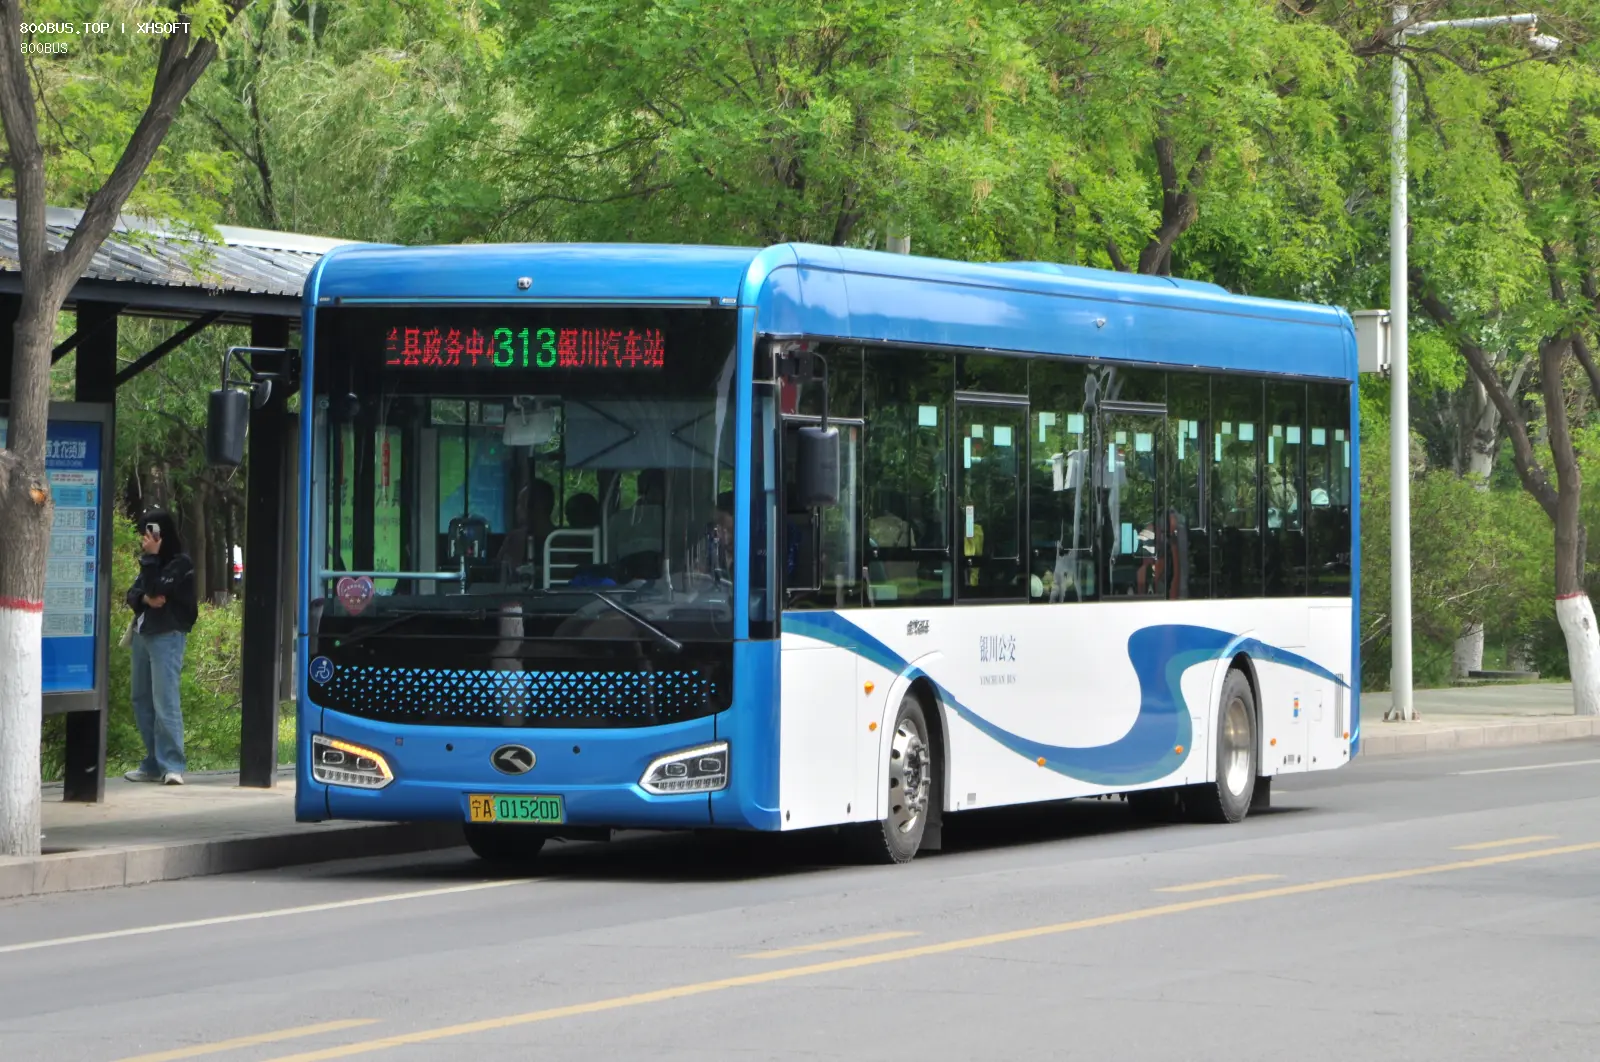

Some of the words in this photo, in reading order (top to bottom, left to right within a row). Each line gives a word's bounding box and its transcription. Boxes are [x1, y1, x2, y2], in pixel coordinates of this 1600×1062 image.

[493, 327, 557, 368] 313
[557, 327, 665, 368] 银川汽车站
[979, 634, 1016, 662] 银川公交
